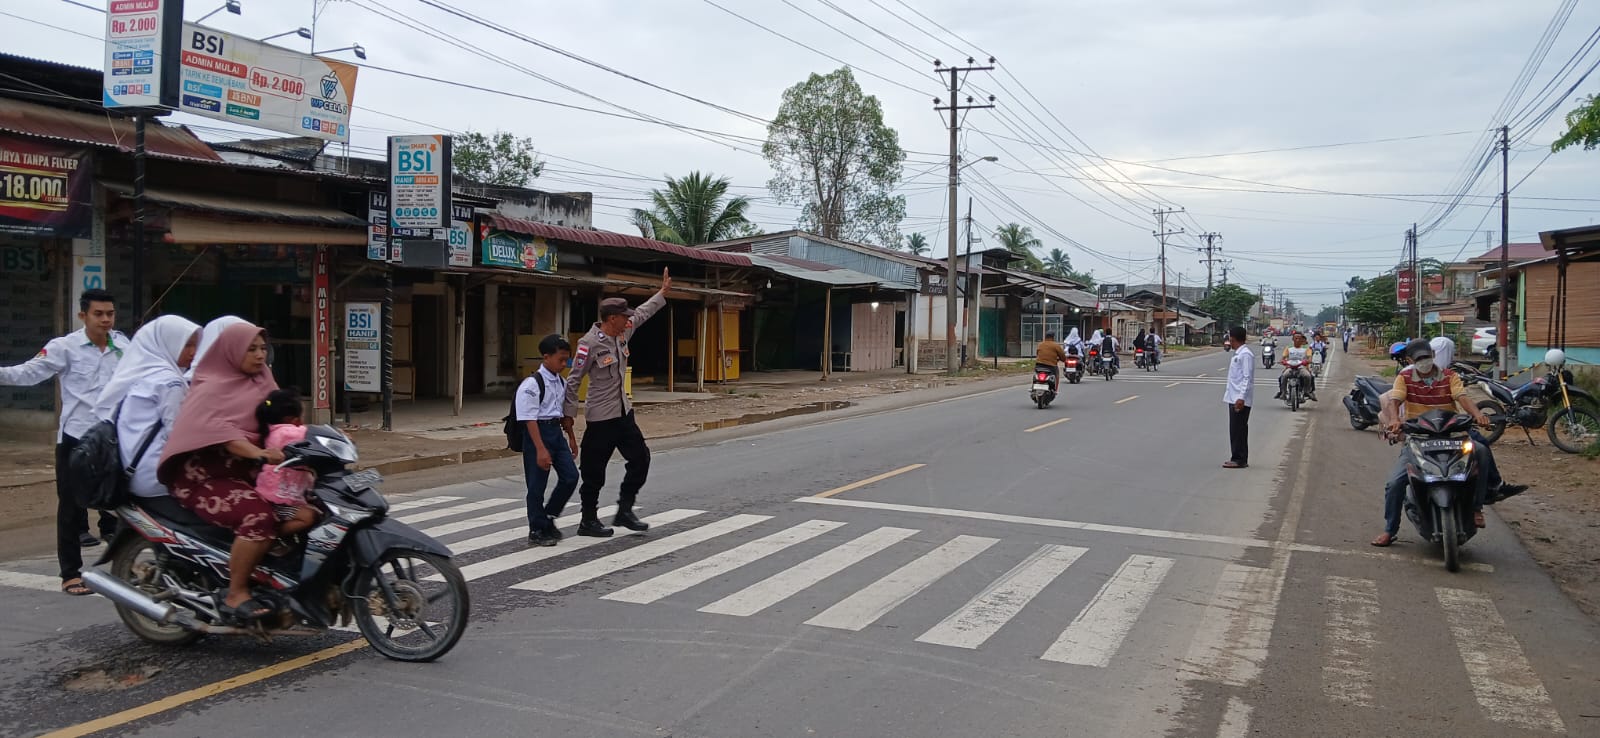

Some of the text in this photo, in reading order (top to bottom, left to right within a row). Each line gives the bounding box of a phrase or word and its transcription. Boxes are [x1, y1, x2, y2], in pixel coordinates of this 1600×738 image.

[112, 17, 156, 34] Rp. 2.000
[192, 31, 223, 56] BSI
[185, 55, 240, 74] ADMIN MULAI
[252, 71, 303, 96] Rp. 2.000
[240, 93, 257, 105] BNI
[23, 153, 49, 167] TANPA
[52, 157, 79, 170] FILTER
[398, 150, 431, 171] BSI
[449, 230, 467, 246] BSI
[4, 248, 43, 272] BSI
[492, 245, 516, 260] DELUX
[349, 313, 371, 328] BSI
[318, 356, 327, 401] 2000
